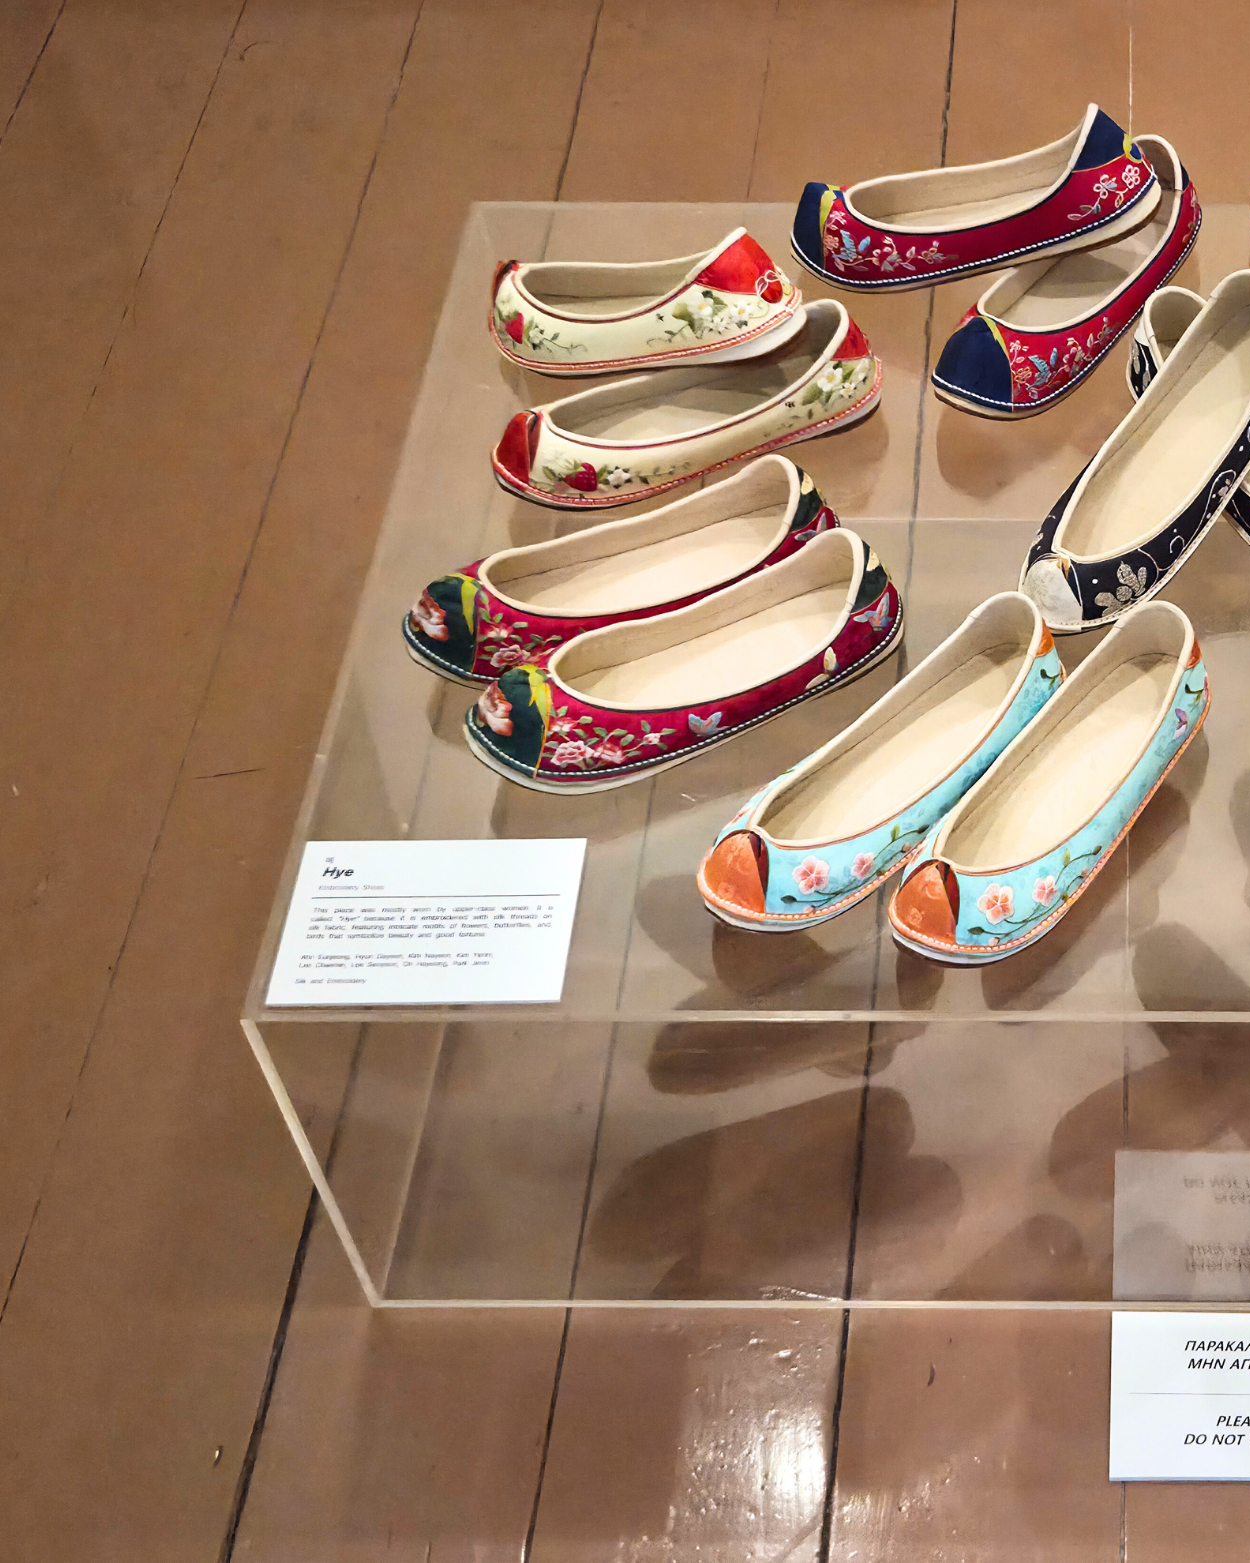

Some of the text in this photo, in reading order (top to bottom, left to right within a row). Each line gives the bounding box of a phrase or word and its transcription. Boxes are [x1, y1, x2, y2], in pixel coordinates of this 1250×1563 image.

[322, 867, 354, 879] Hye
[1188, 1358, 1226, 1369] ΜΗΝ
[1184, 1434, 1207, 1445] DO
[1212, 1434, 1245, 1445] NOT
